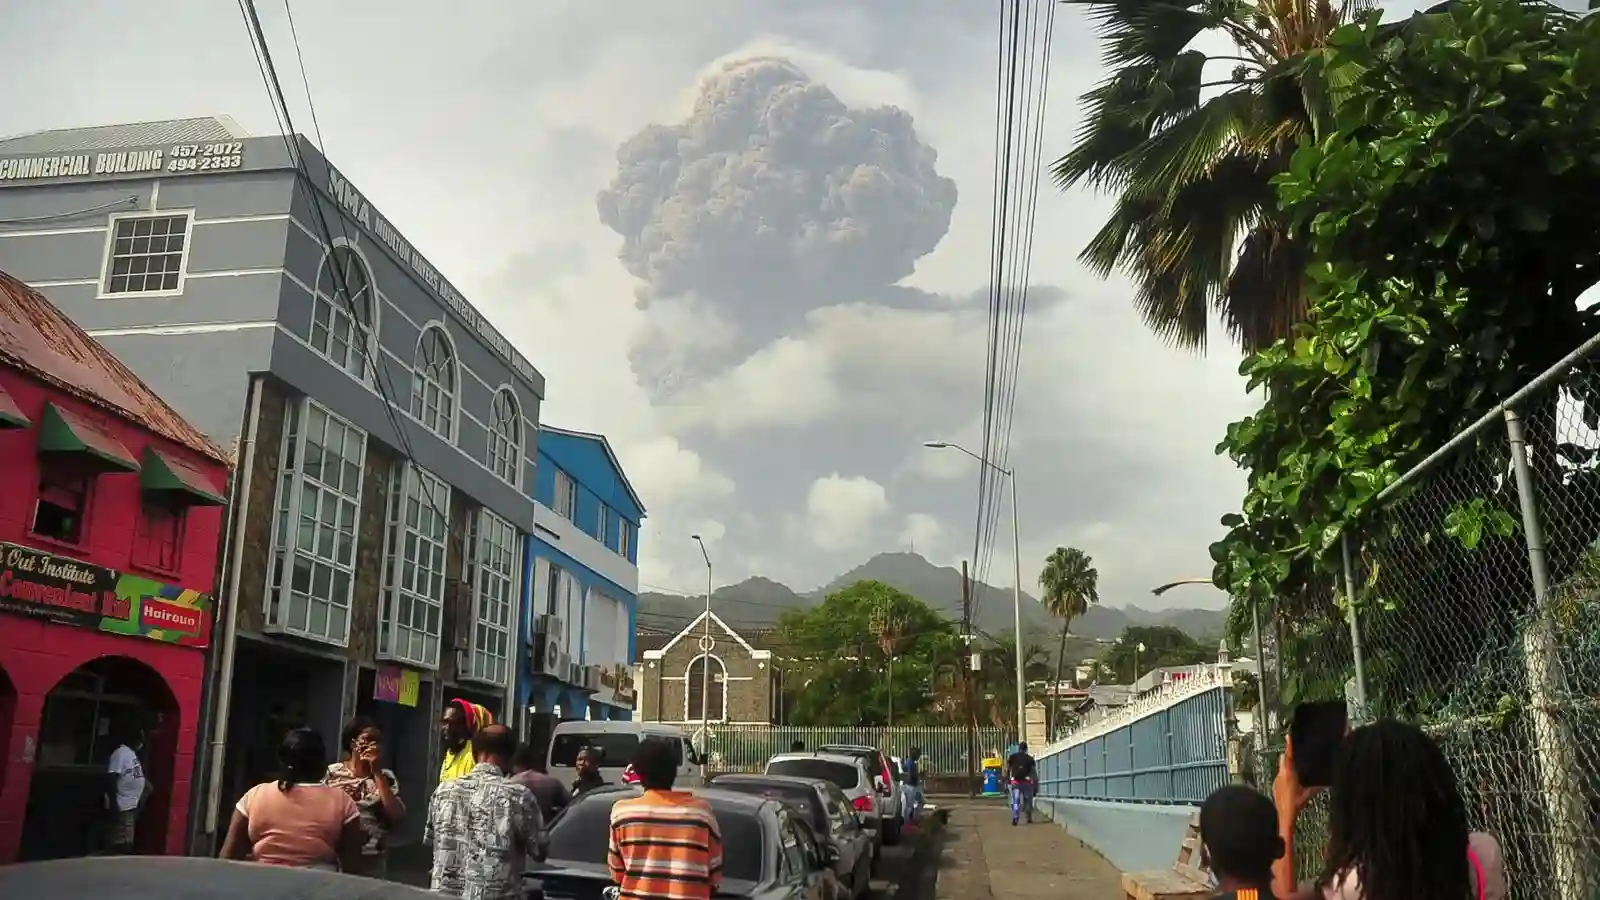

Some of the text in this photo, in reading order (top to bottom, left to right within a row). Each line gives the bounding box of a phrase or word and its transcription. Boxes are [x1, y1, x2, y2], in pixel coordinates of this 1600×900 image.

[170, 142, 243, 157] 457-2072
[0, 150, 164, 180] COMMERCIAL BUILDING
[168, 154, 242, 172] 494-2333
[327, 169, 371, 231] MMA
[8, 549, 36, 572] Out
[38, 556, 96, 584] Institute
[144, 604, 195, 626] Hairoun
